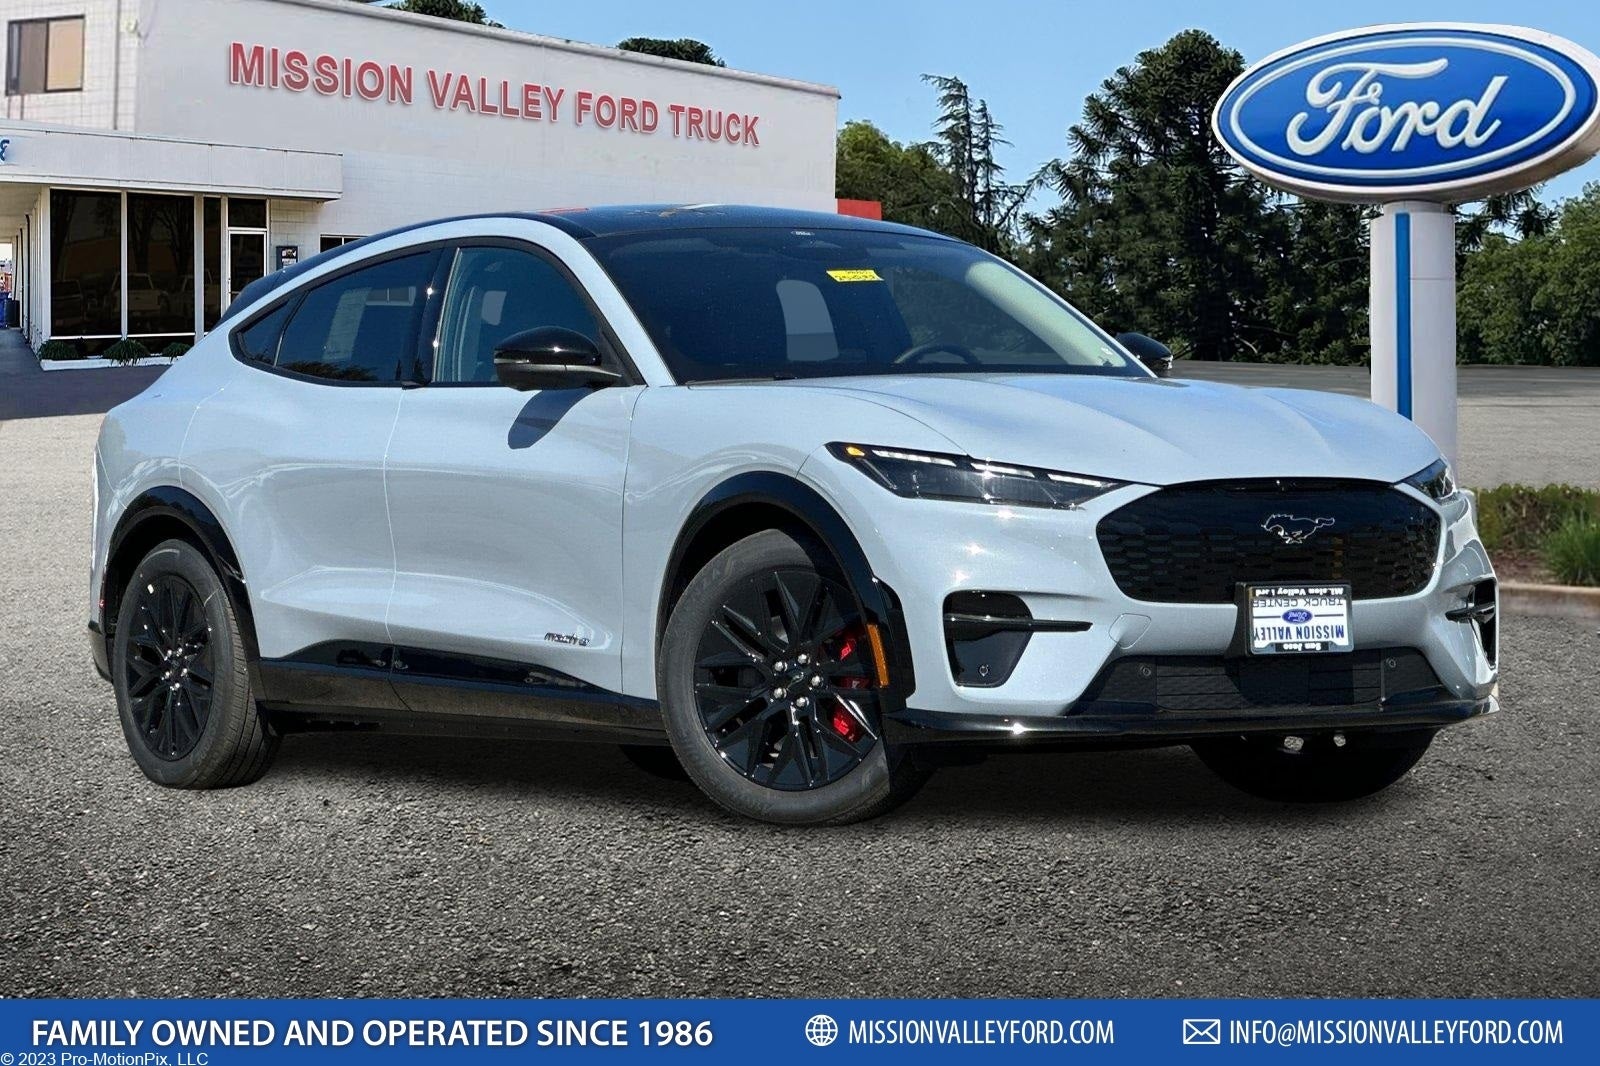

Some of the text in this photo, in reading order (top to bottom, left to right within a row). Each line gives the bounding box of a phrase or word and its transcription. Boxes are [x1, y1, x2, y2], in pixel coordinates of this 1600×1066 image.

[230, 41, 760, 146] MISSION VALLEY FORD TRUCK
[1286, 58, 1509, 156] Ford
[1304, 598, 1344, 607] TRUCK
[1287, 611, 1307, 622] Ford
[1253, 625, 1344, 641] MISSION VALLEY
[1305, 642, 1321, 651] San
